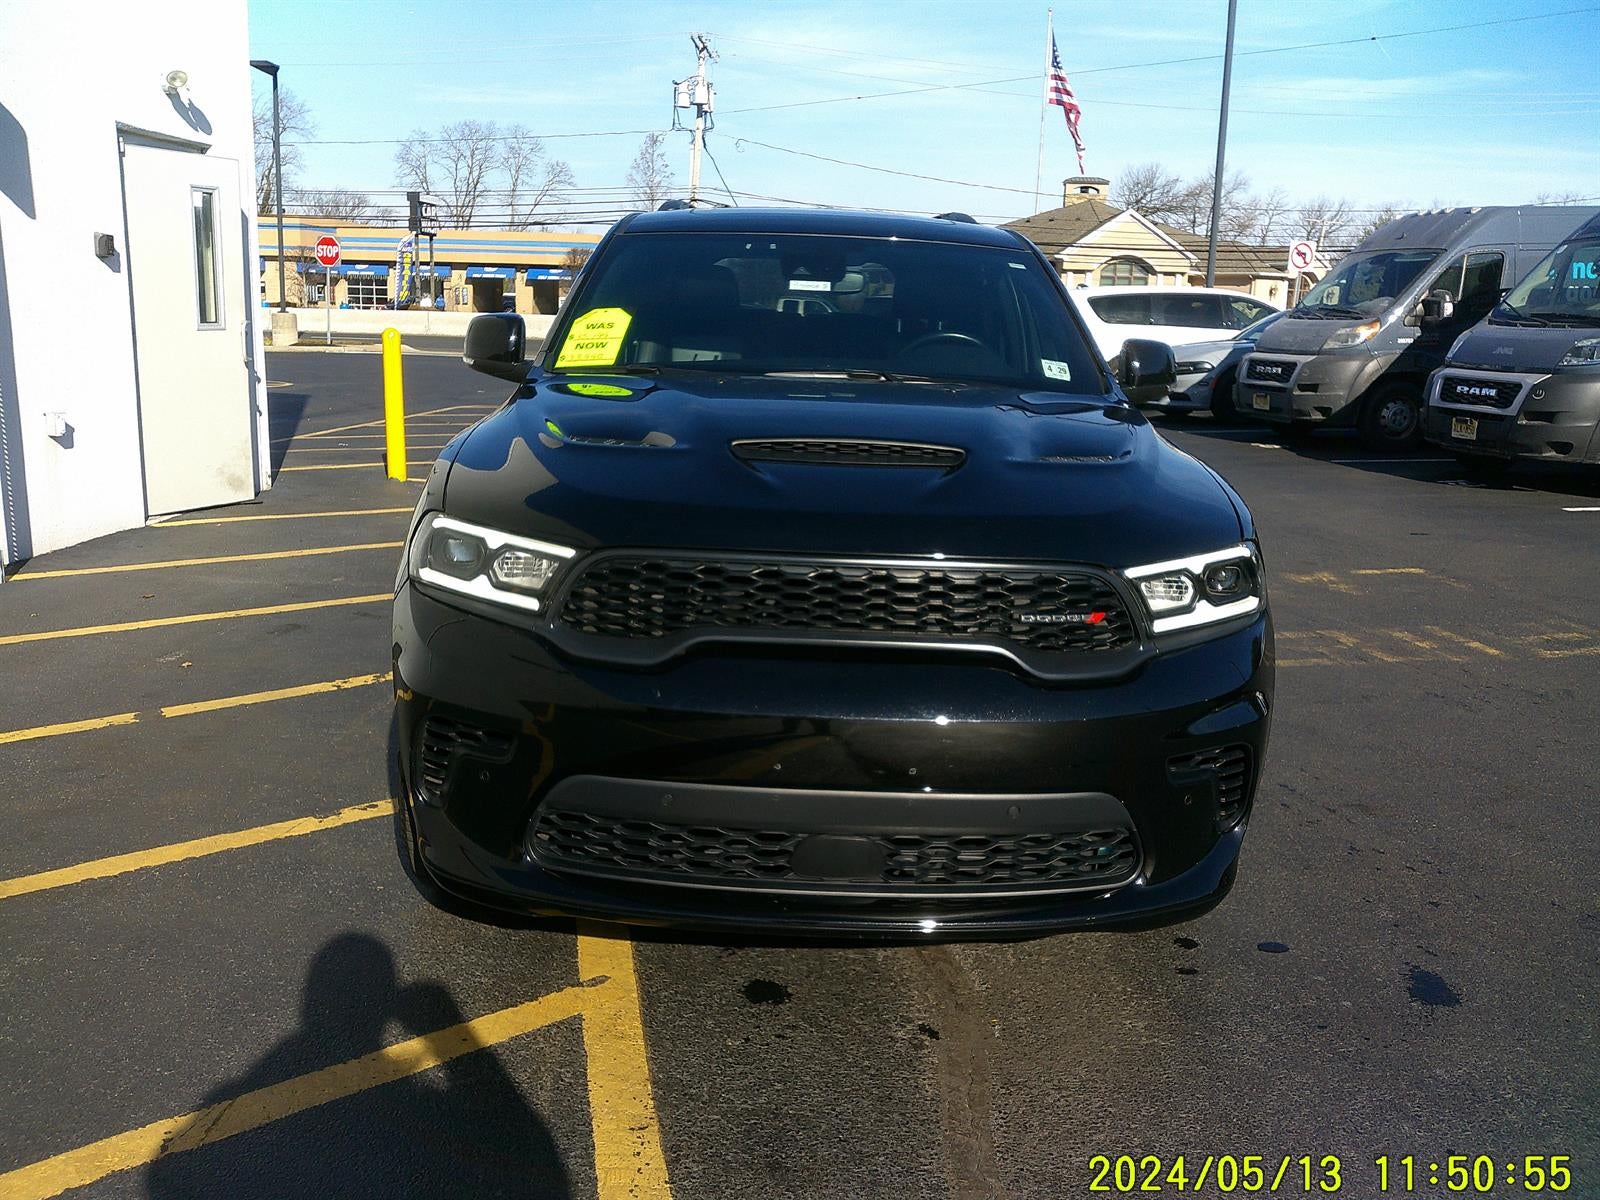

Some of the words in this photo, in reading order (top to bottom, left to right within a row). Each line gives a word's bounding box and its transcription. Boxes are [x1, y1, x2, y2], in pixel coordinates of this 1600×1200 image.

[317, 244, 339, 258] STOP
[585, 321, 615, 330] WAS
[573, 341, 609, 351] NOW
[1057, 366, 1067, 375] 29
[1456, 385, 1498, 397] RAM
